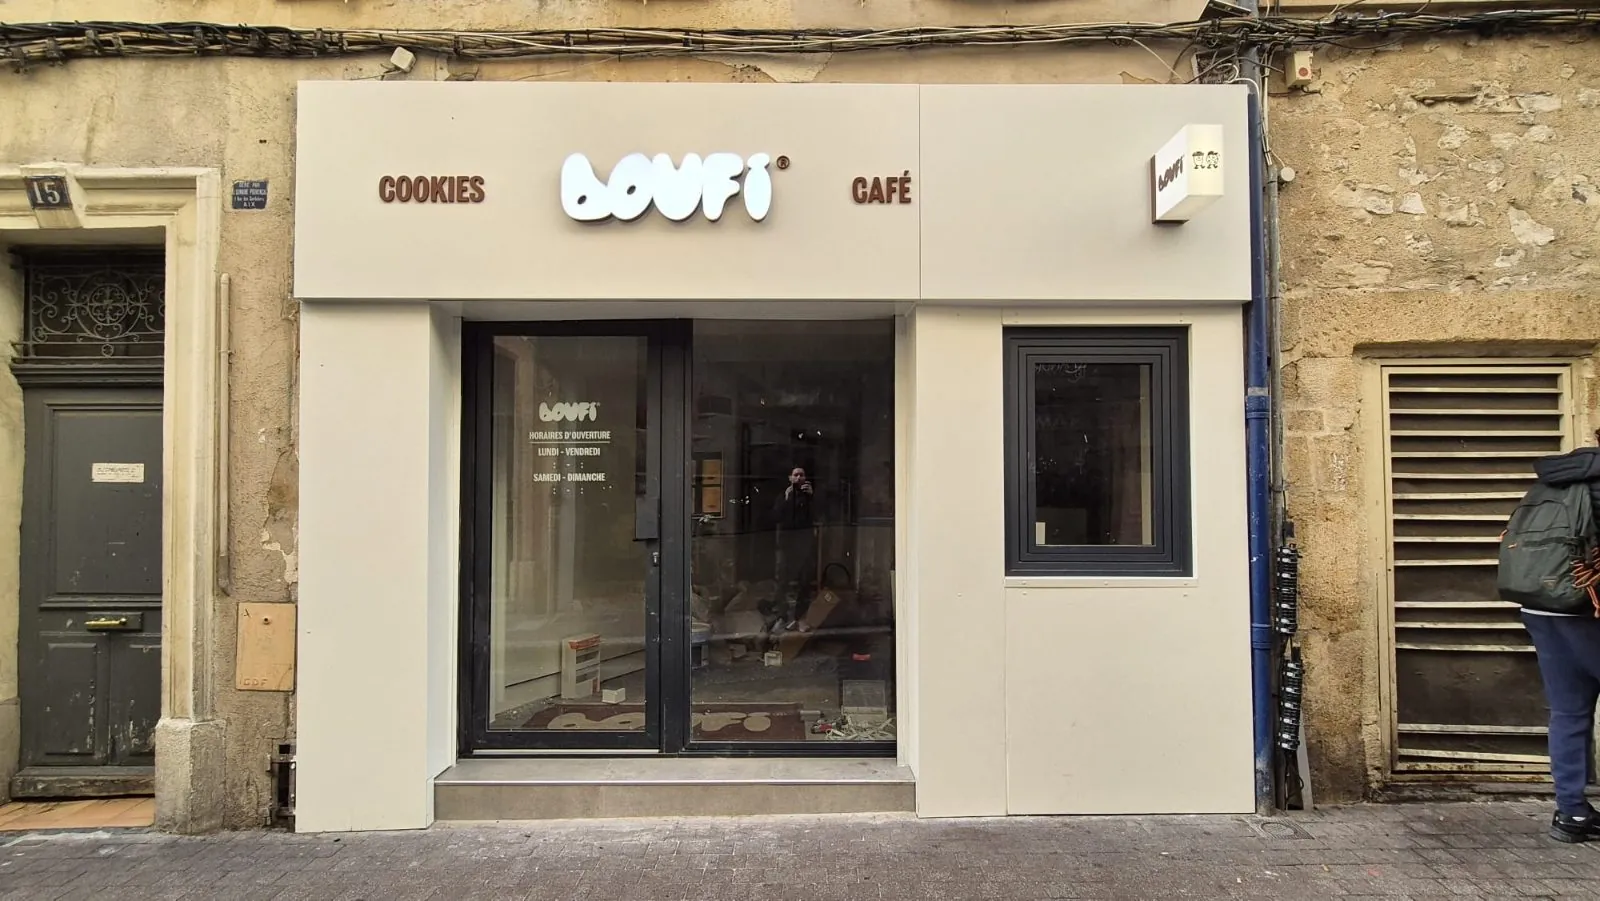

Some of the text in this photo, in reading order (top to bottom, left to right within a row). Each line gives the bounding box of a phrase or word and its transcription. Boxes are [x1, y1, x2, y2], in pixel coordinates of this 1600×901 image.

[32, 181, 61, 204] 15
[379, 175, 486, 203] COOKIES
[852, 170, 912, 204] CAFÉ
[529, 430, 611, 440] HORAIRES D'OUVERTURE
[538, 447, 559, 457] LUNDI
[565, 447, 601, 456] VENDREDI
[533, 473, 561, 482] SAMEDI
[567, 472, 606, 482] DIMANCHE
